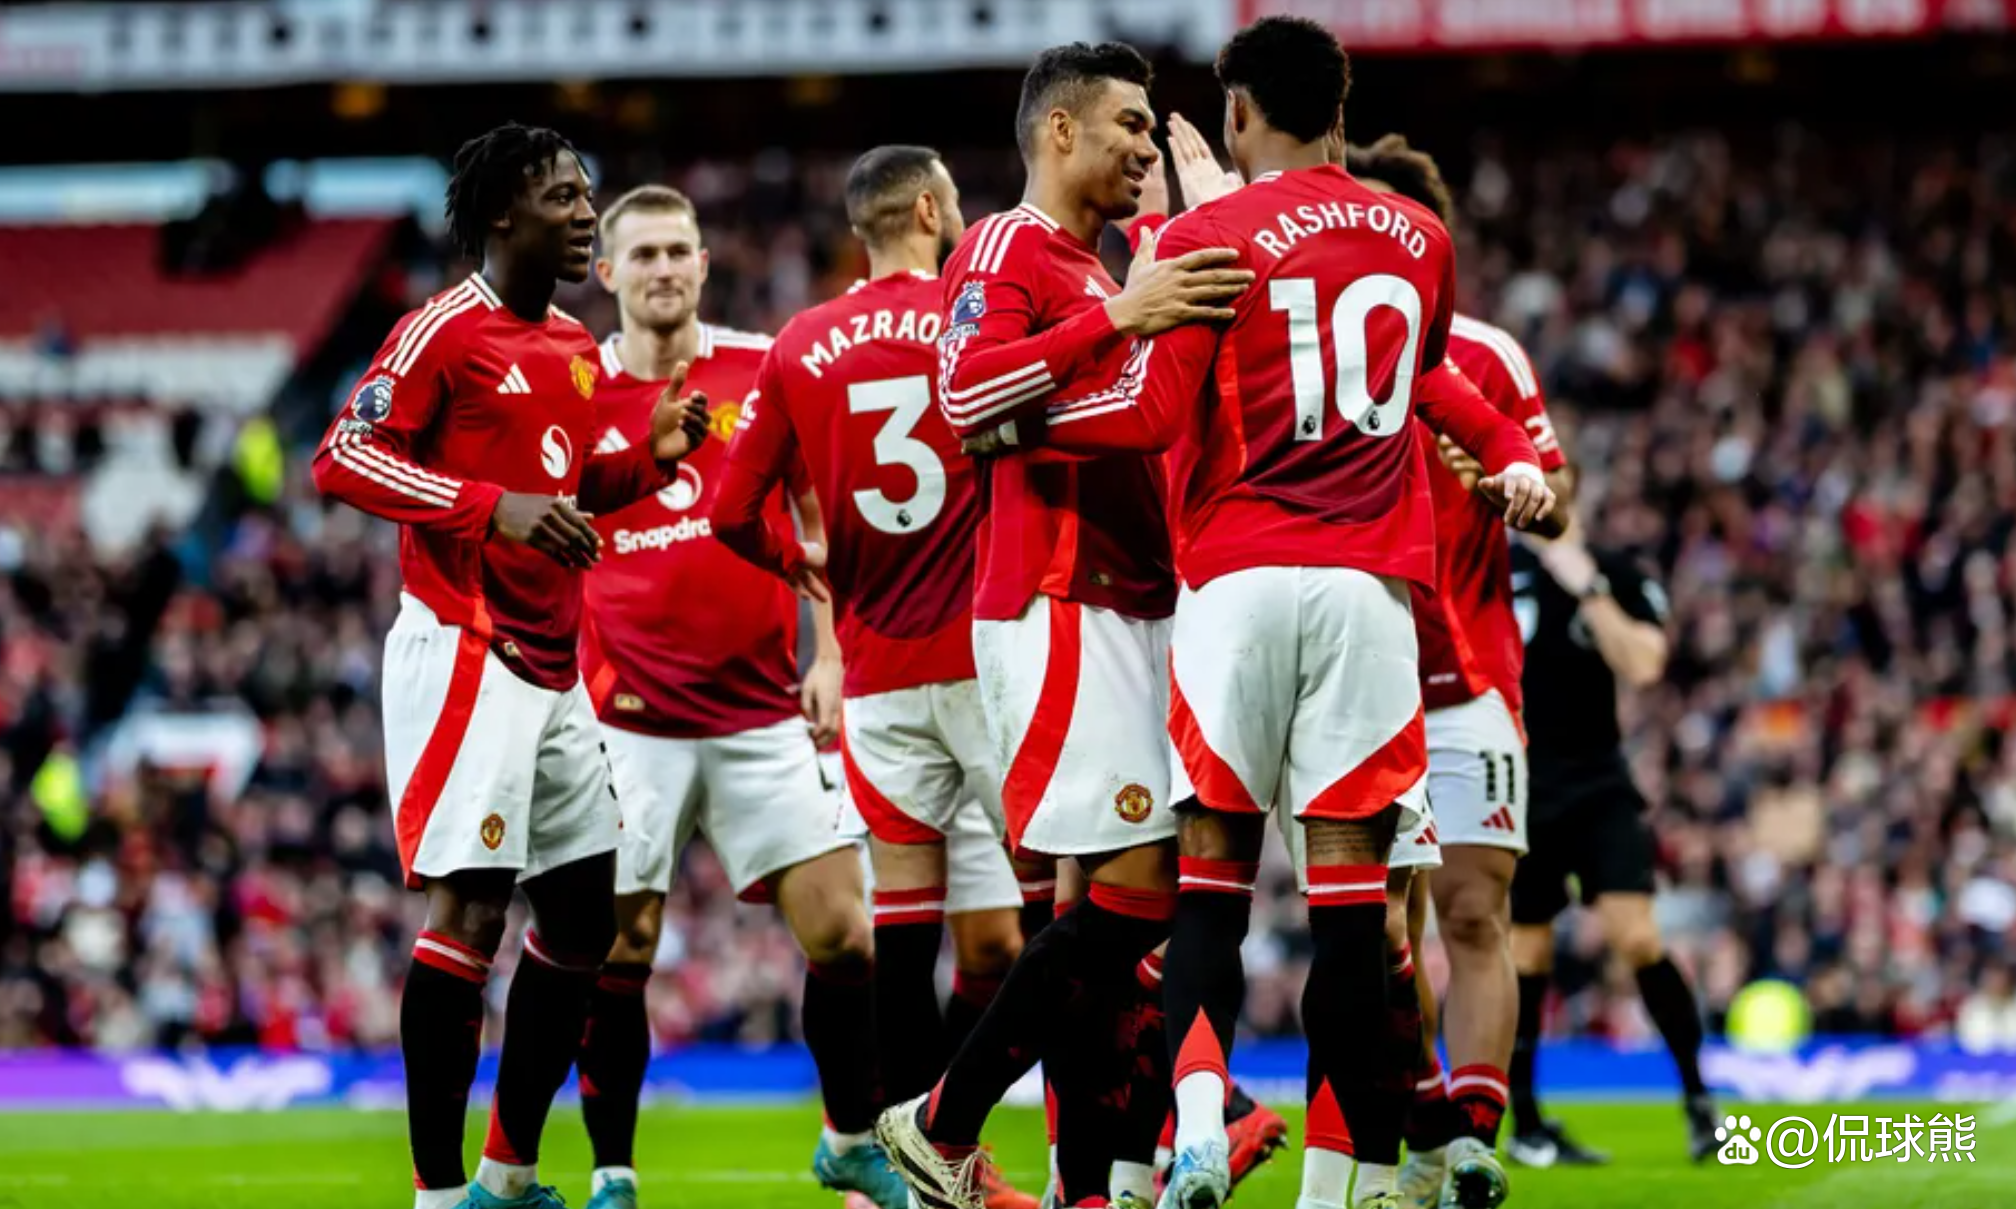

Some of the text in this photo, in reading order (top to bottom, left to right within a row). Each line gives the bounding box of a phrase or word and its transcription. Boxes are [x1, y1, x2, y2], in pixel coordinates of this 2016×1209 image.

[1253, 200, 1427, 260] RASHFORD
[1268, 273, 1421, 442] 10
[848, 375, 947, 535] 3
[1478, 750, 1516, 805] 11
